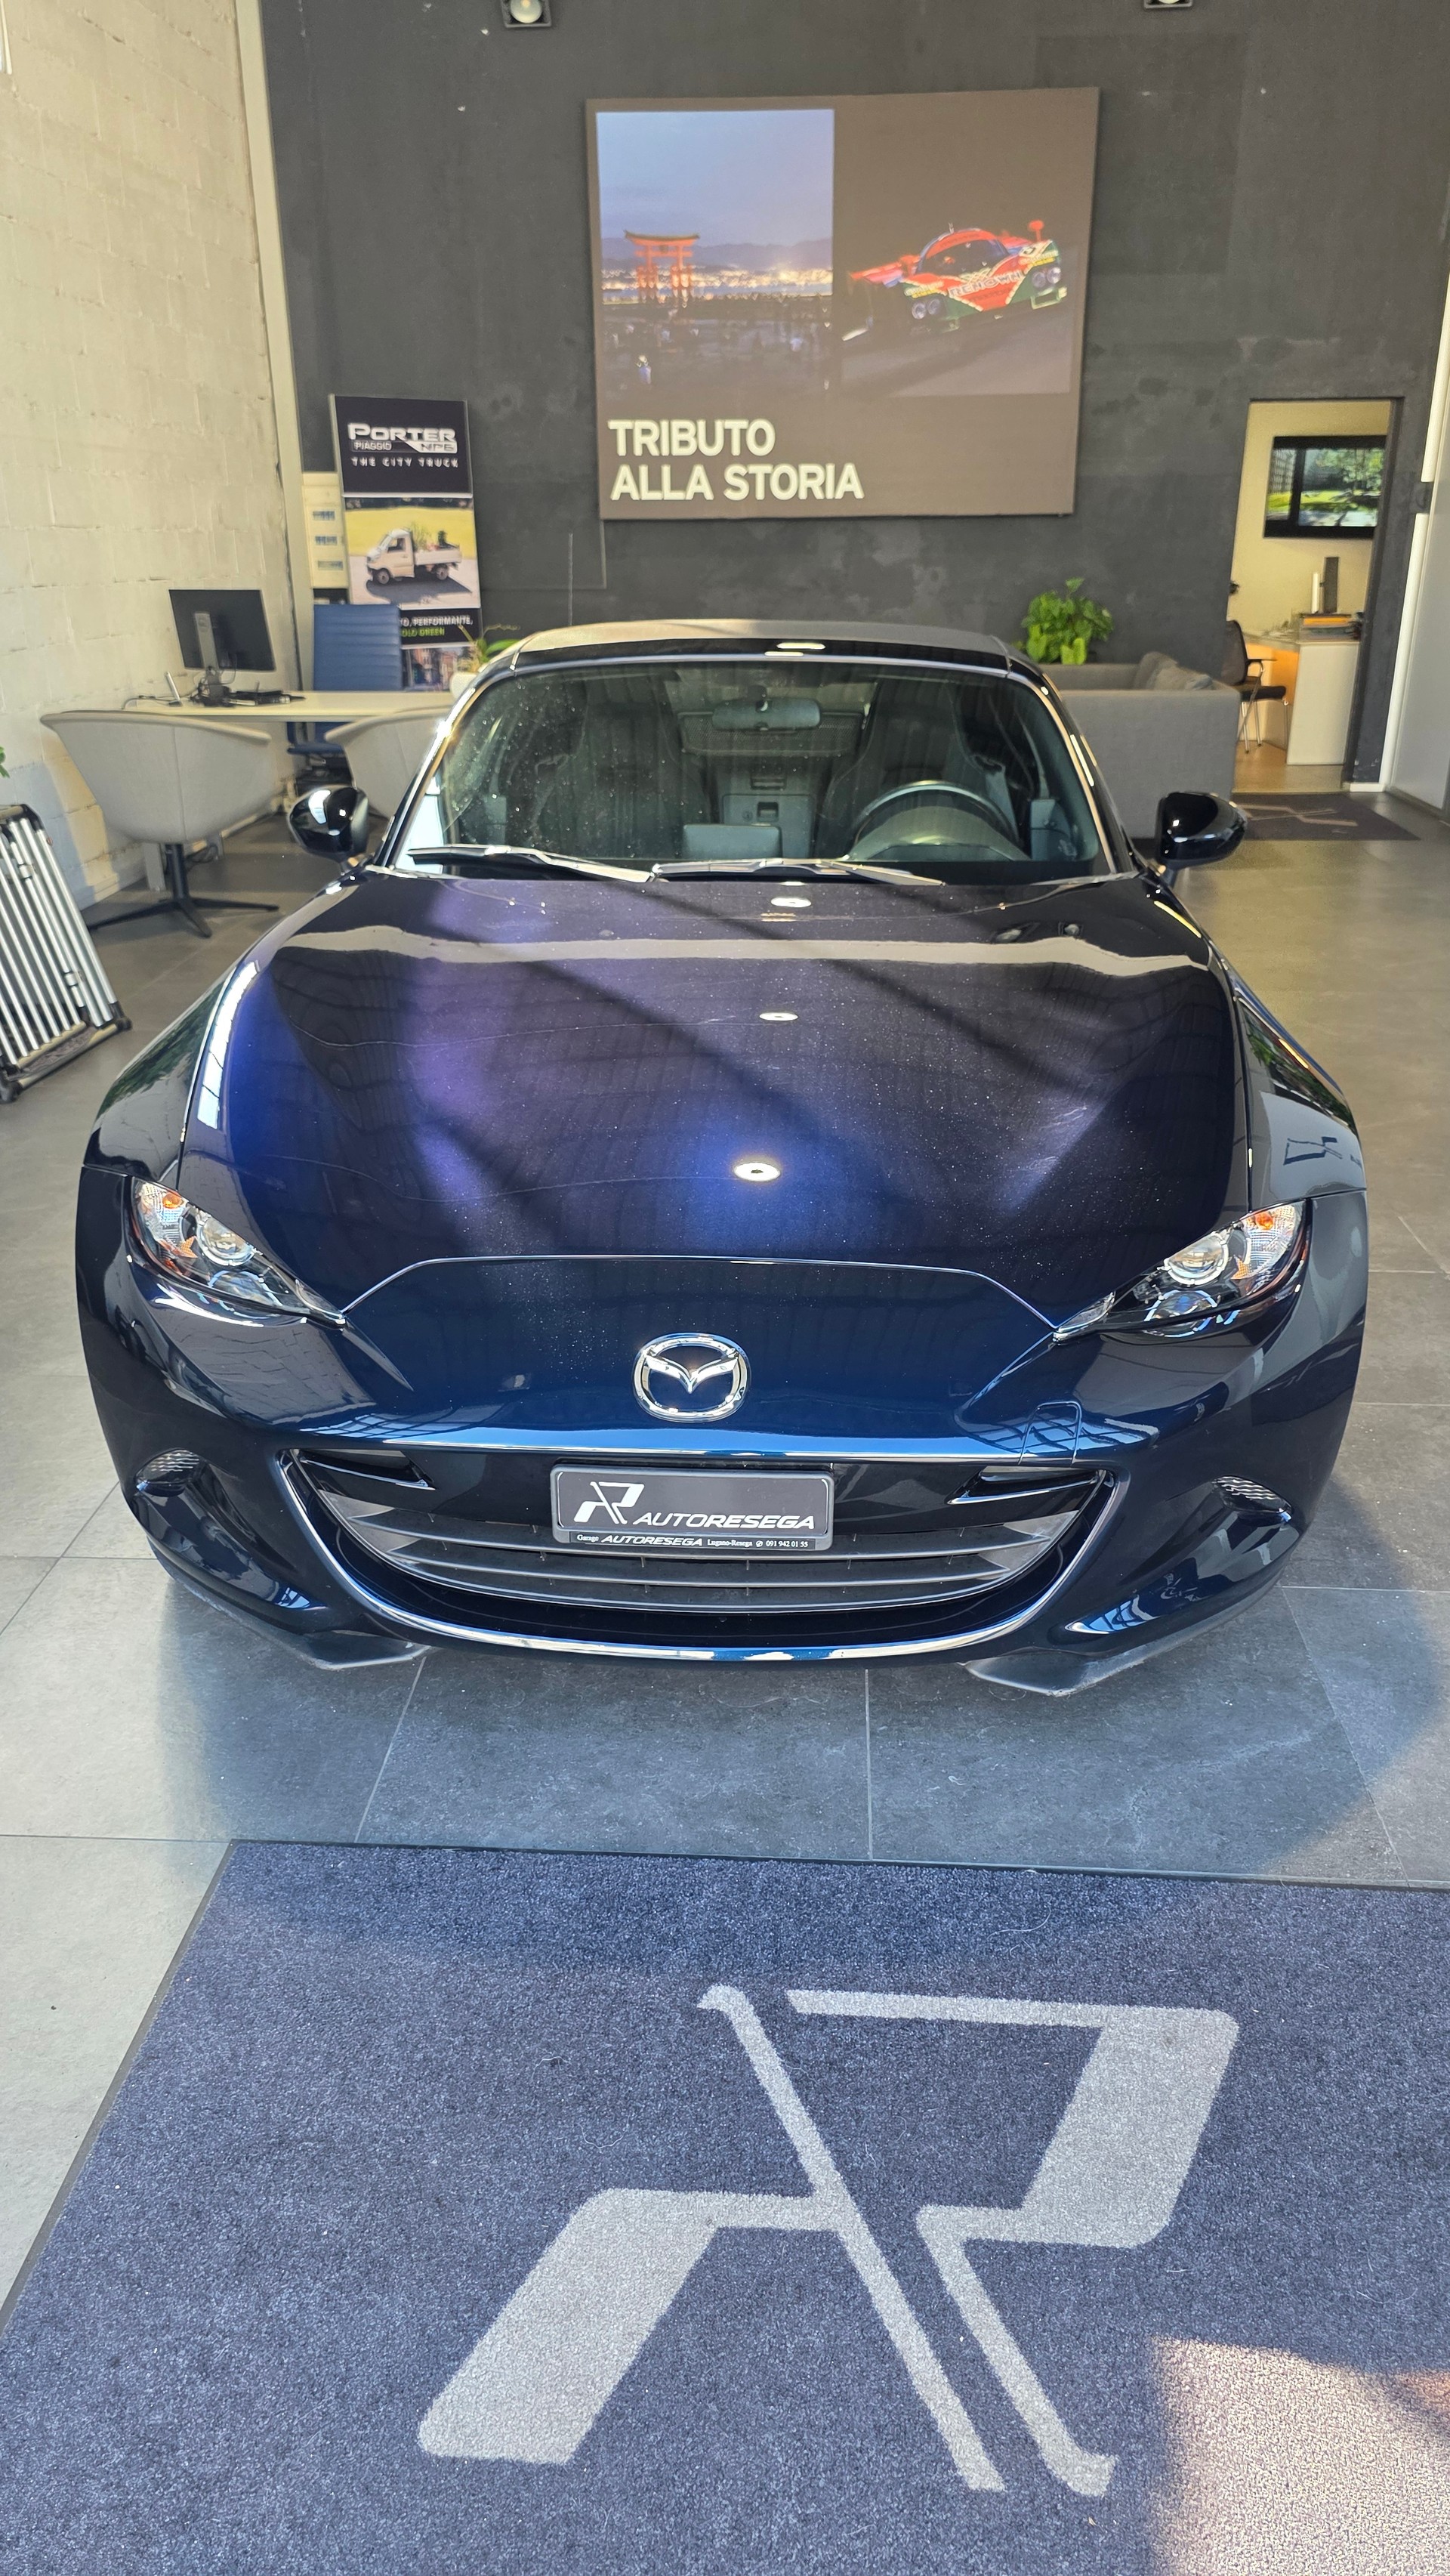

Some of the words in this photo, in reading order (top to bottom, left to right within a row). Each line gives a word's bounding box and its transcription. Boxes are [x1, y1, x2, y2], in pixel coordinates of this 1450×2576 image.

[347, 422, 456, 442] PORTER
[608, 419, 776, 456] TRIBUTO
[351, 456, 376, 467] THE
[382, 456, 412, 467] CITY
[418, 456, 458, 468] TRUCK
[610, 463, 714, 500] ALLA
[723, 462, 865, 500] STORIA
[632, 1512, 815, 1530] AUTORESEGA
[576, 1534, 600, 1543] Garage
[601, 1535, 702, 1546] AUTORESEGA
[707, 1539, 753, 1548] Lugano-Resega
